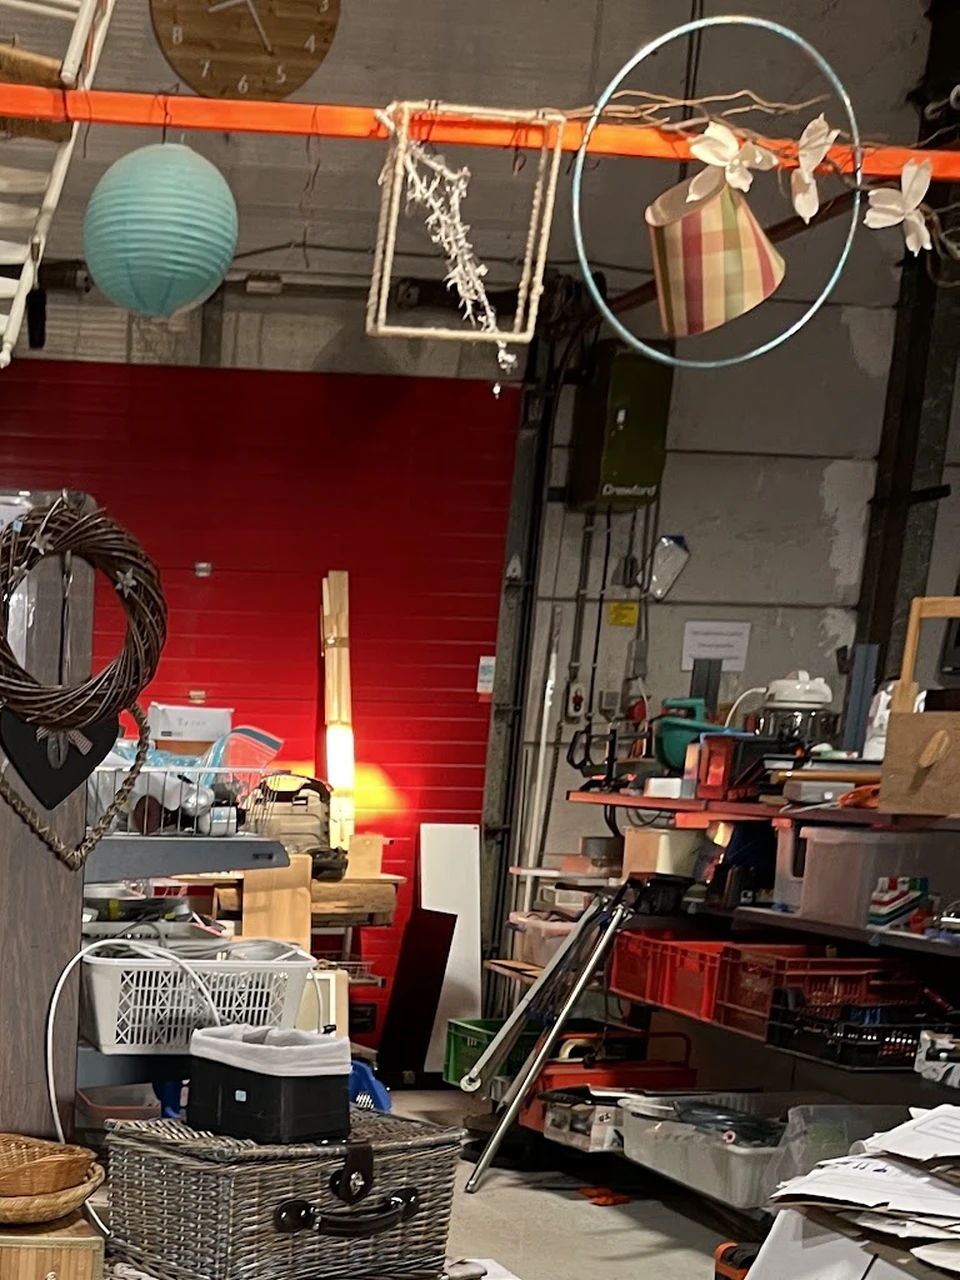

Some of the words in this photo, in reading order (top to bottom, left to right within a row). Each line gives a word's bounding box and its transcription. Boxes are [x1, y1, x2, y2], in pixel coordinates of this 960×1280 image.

[172, 26, 183, 45] 8
[304, 33, 316, 54] 4
[200, 59, 210, 78] 7
[276, 65, 287, 84] 5
[237, 74, 248, 94] 6
